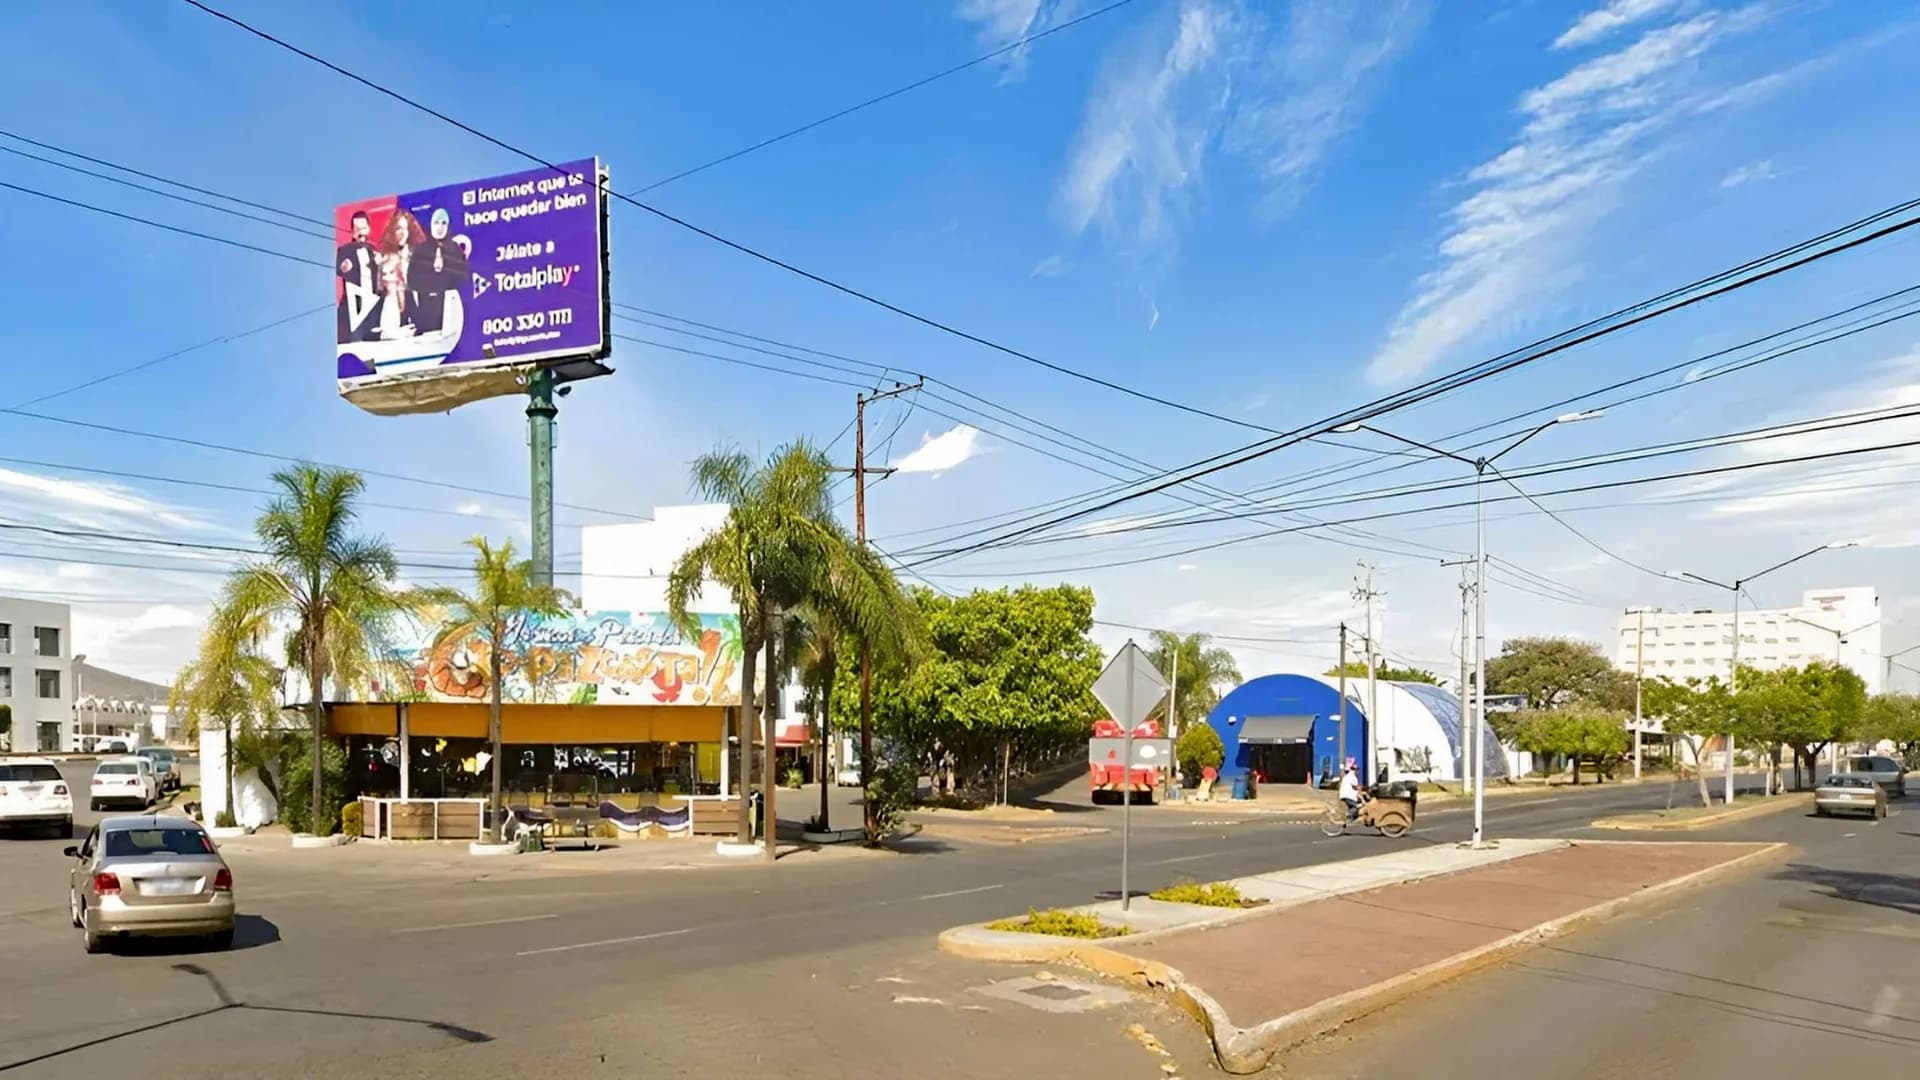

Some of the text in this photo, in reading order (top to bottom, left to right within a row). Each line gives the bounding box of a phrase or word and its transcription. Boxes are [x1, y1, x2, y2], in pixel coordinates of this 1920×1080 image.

[463, 190, 476, 206] El
[537, 176, 566, 195] que
[464, 193, 587, 226] hace quedar bien
[494, 264, 573, 292] Totalplay
[482, 308, 573, 335] 800 330 1111
